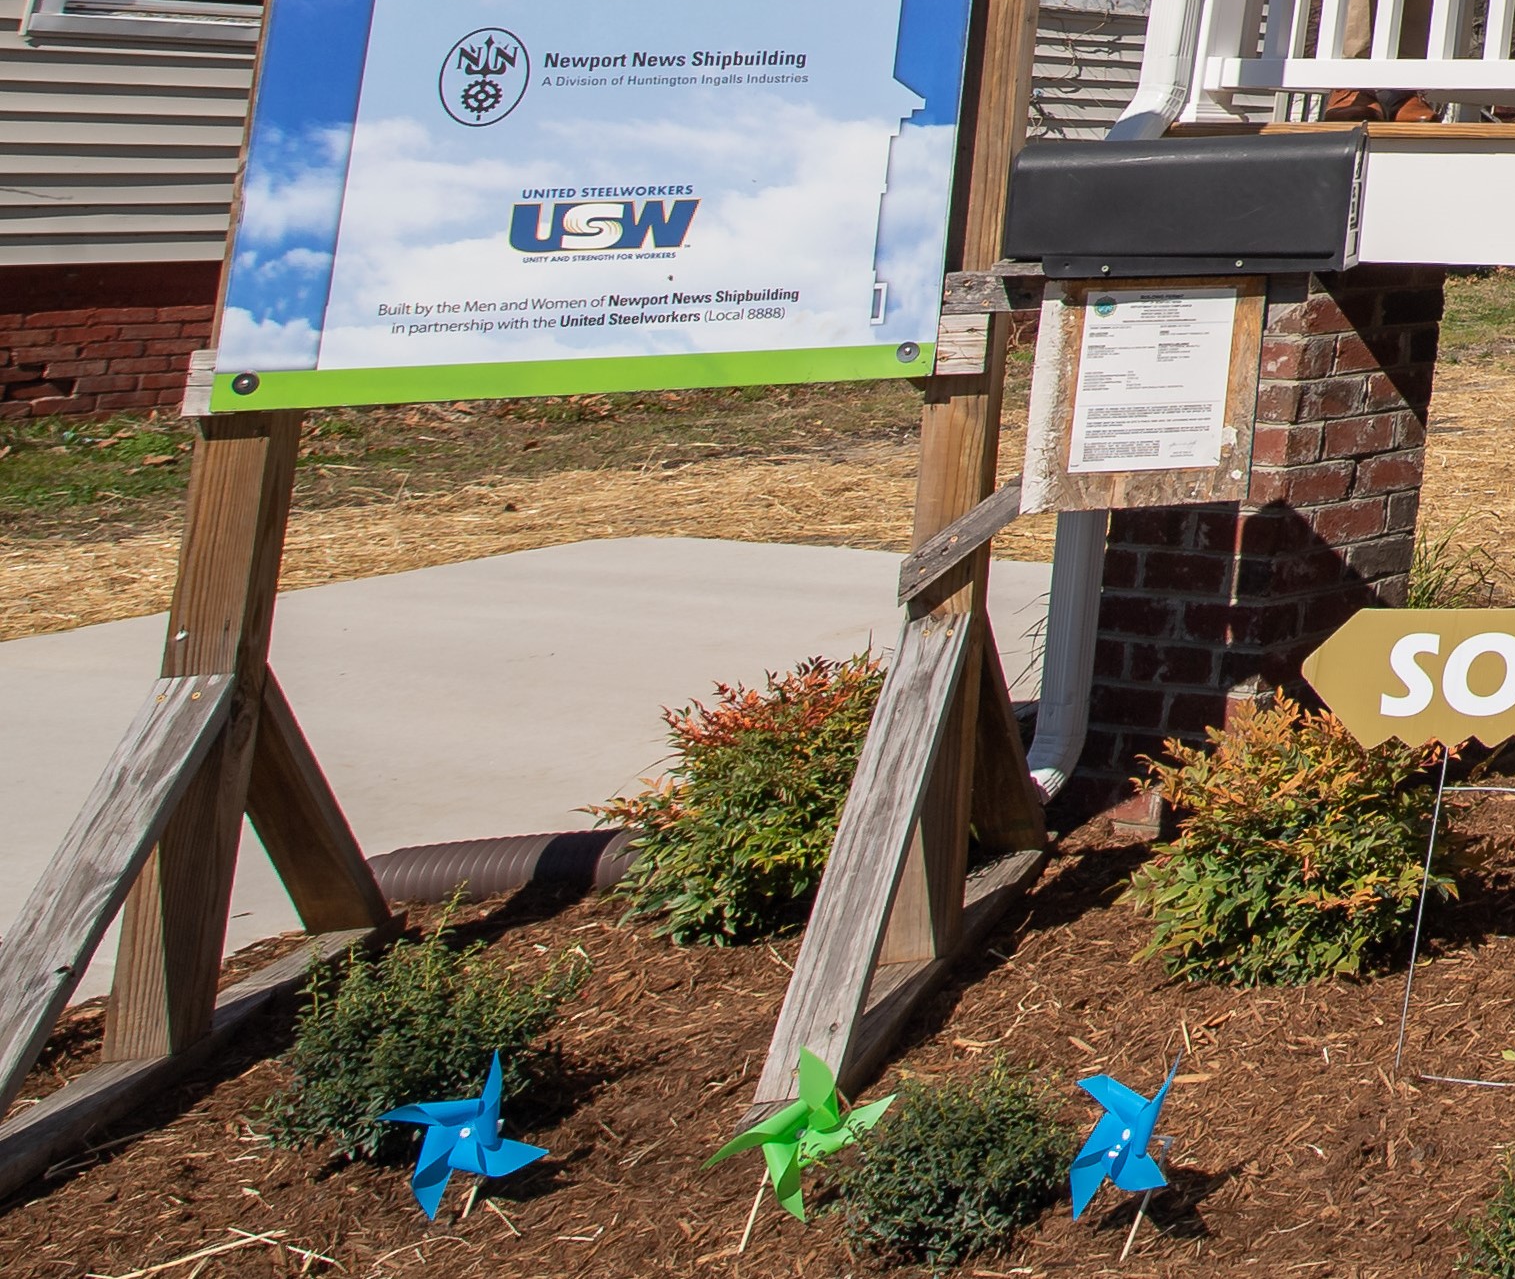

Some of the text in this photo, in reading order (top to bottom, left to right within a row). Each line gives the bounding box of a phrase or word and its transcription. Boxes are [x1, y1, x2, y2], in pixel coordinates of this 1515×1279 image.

[544, 50, 807, 72] Newport News Shipbuilding
[542, 73, 809, 88] A Division of Huntington Ingalls Industries
[522, 185, 693, 200] UNITED STEELWORKERS
[508, 199, 702, 253] USW
[522, 252, 677, 264] UNITY AND STRENGTH FOR WORKERS
[378, 288, 800, 318] Built by the Men and Women of Newport News Shipbuilding
[391, 306, 786, 336] in partnership with the United Steelworkers (Local 8888)
